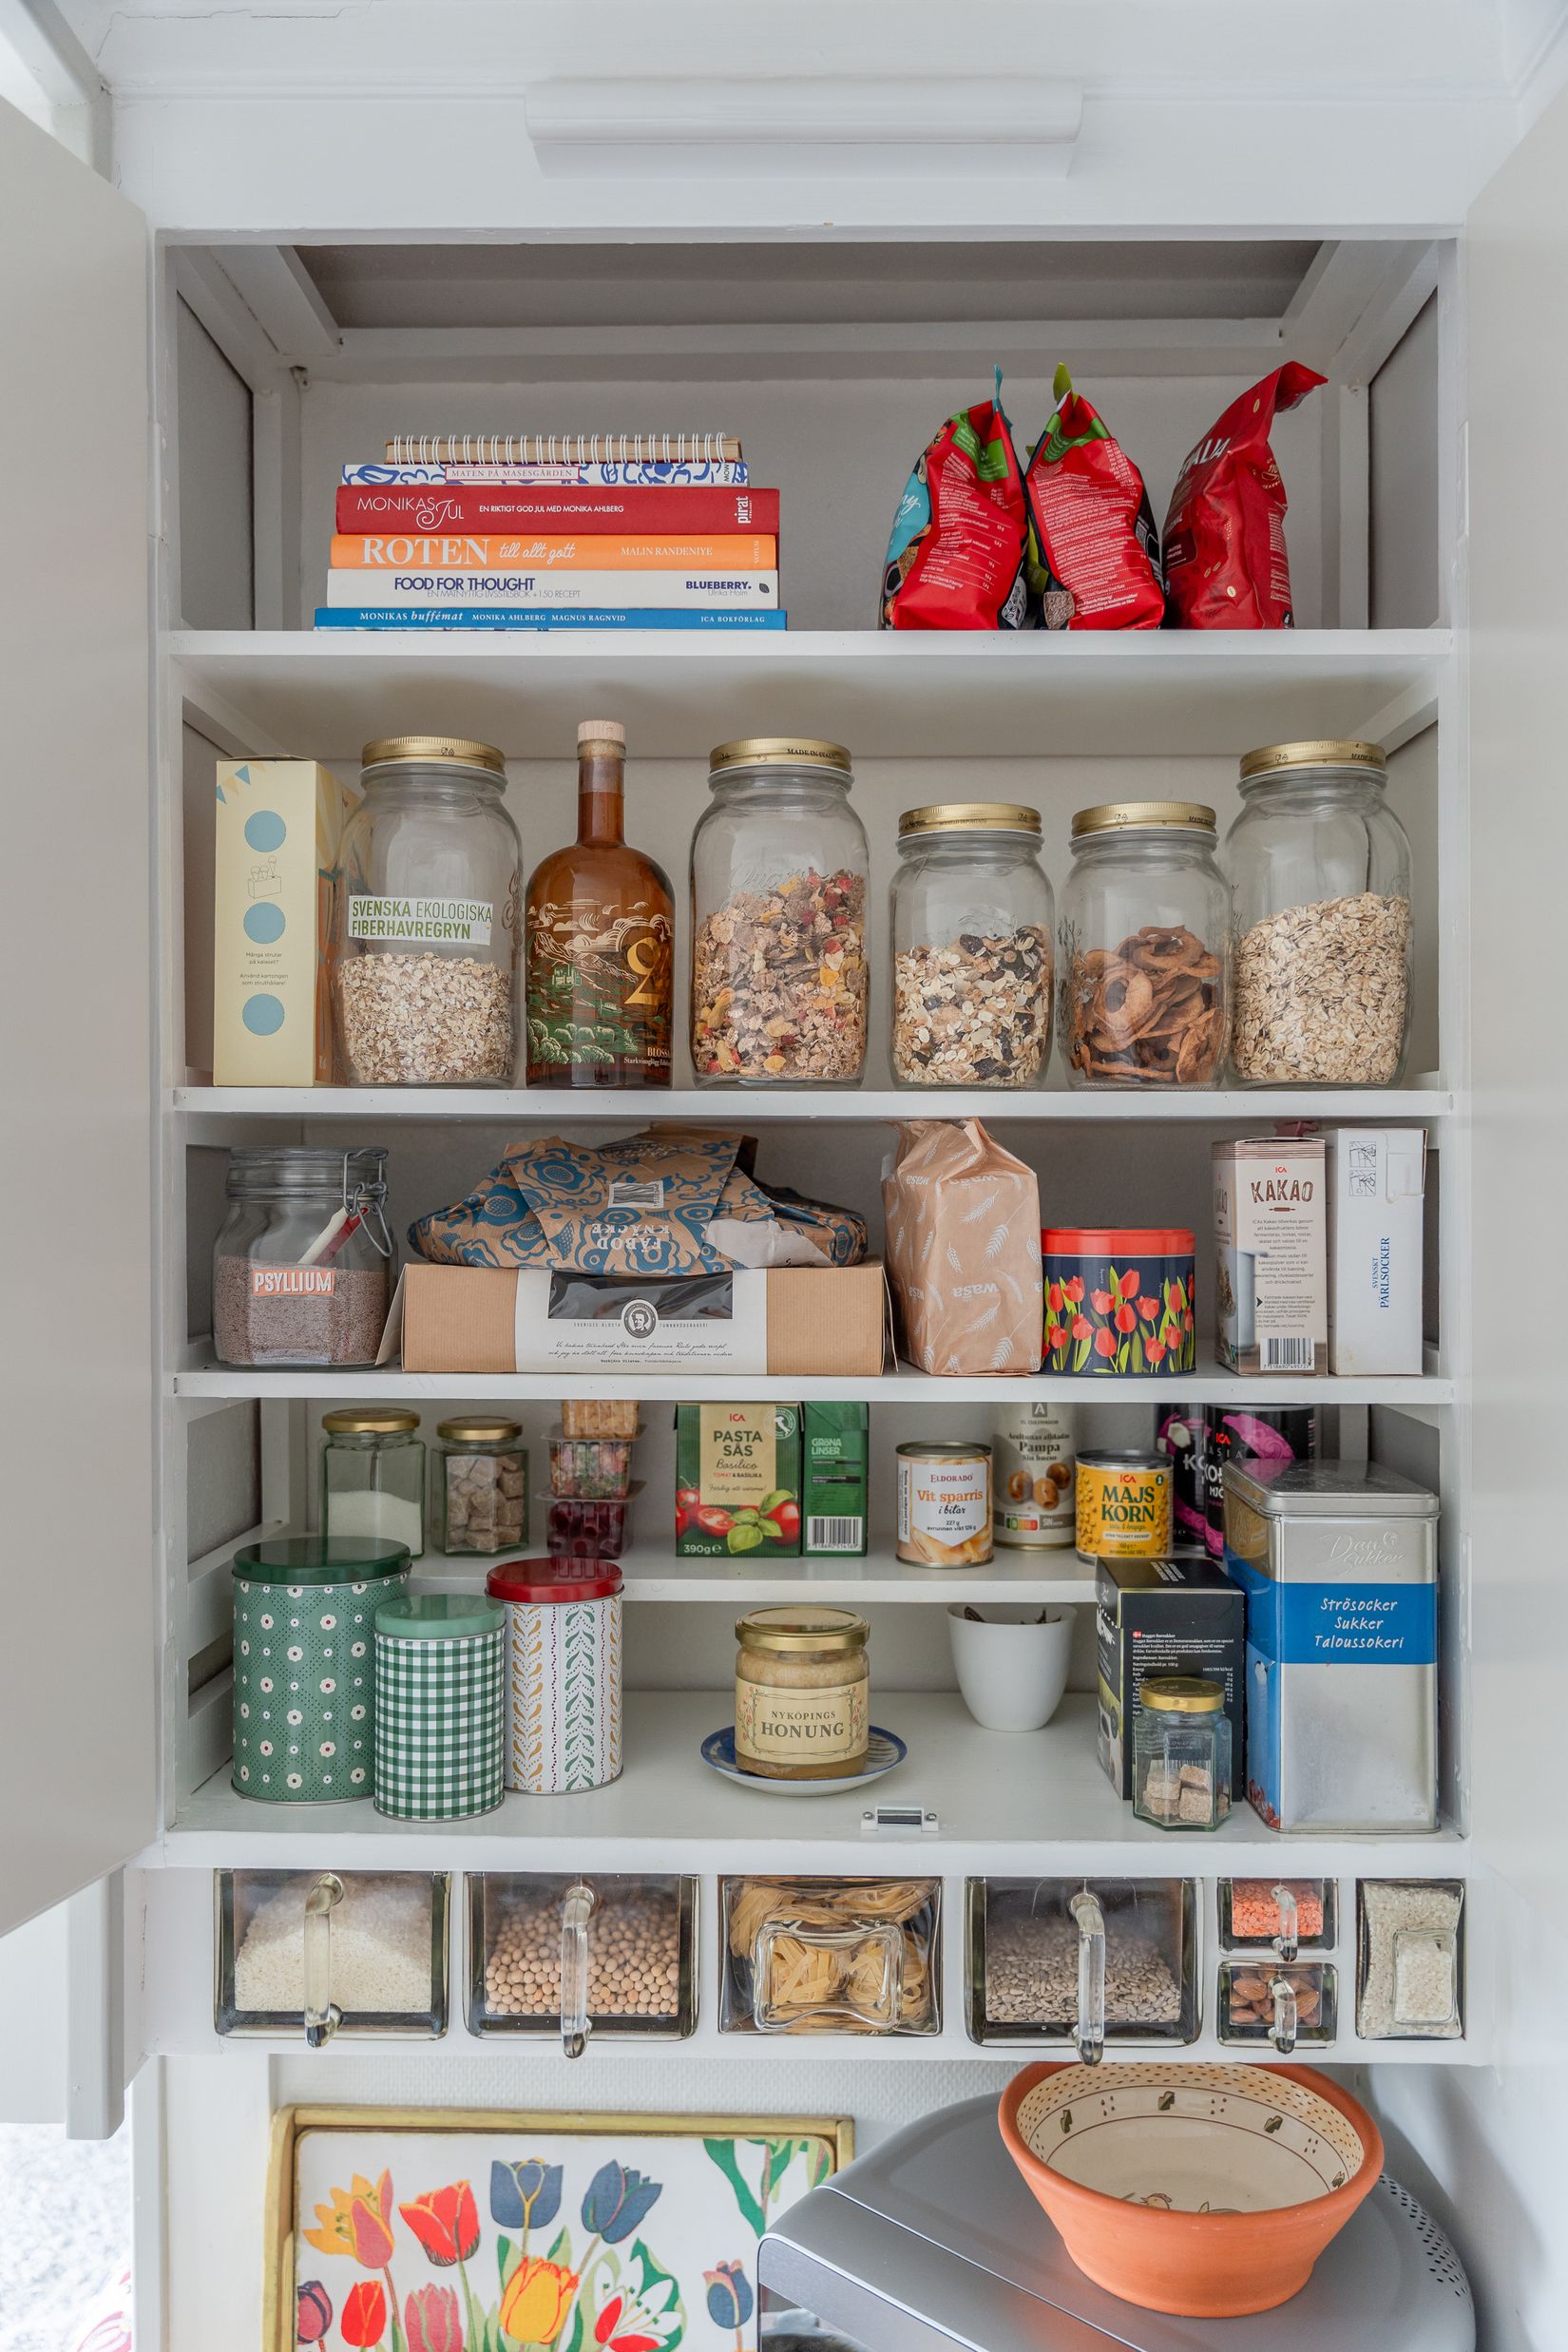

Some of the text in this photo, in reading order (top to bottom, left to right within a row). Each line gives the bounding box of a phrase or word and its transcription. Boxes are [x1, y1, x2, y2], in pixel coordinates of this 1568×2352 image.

[487, 468, 499, 477] PÅ
[504, 468, 572, 477] MASESGÅRDEN
[357, 497, 435, 511] MONIKAS
[735, 496, 751, 524] pirat
[361, 538, 575, 564] ROTEN till allt gott
[655, 547, 713, 556] RANDENIYE
[394, 578, 535, 590] FOOD FOR THOUGHT
[360, 610, 463, 622] MONIKAS buffémat
[717, 614, 765, 622] BOKFÖRLAG
[352, 901, 492, 924] SVENSKA EKOLOGISKA
[352, 920, 471, 940] FIBERHAVREGRYN
[1251, 1179, 1313, 1203] KAKAO
[593, 1223, 669, 1237] KNÄCKE
[597, 1237, 661, 1252] FÄBOD
[1378, 1236, 1389, 1309] PÄRLSOCKER
[255, 1272, 332, 1292] PSYLLIUM
[952, 1283, 1000, 1298] wasa
[730, 1413, 745, 1422] ICA
[714, 1430, 763, 1443] PASTA
[812, 1438, 842, 1446] GRÖNA
[1216, 1433, 1231, 1444] ICA
[723, 1443, 754, 1456] SÅS
[812, 1446, 840, 1455] LINSER
[1020, 1442, 1060, 1454] Pampa
[1209, 1446, 1243, 1459] ASIA
[717, 1459, 759, 1469] Basilico
[917, 1489, 984, 1504] Vit sparris
[1102, 1485, 1155, 1503] MAJS
[944, 1504, 966, 1514] bitar
[1101, 1504, 1155, 1521] KORN
[683, 1544, 710, 1555] 390g
[1321, 1597, 1398, 1612] Strösocker
[1334, 1616, 1384, 1630] Sukker
[1315, 1635, 1404, 1649] Taloussokeri
[761, 1722, 845, 1739] HONUNG
